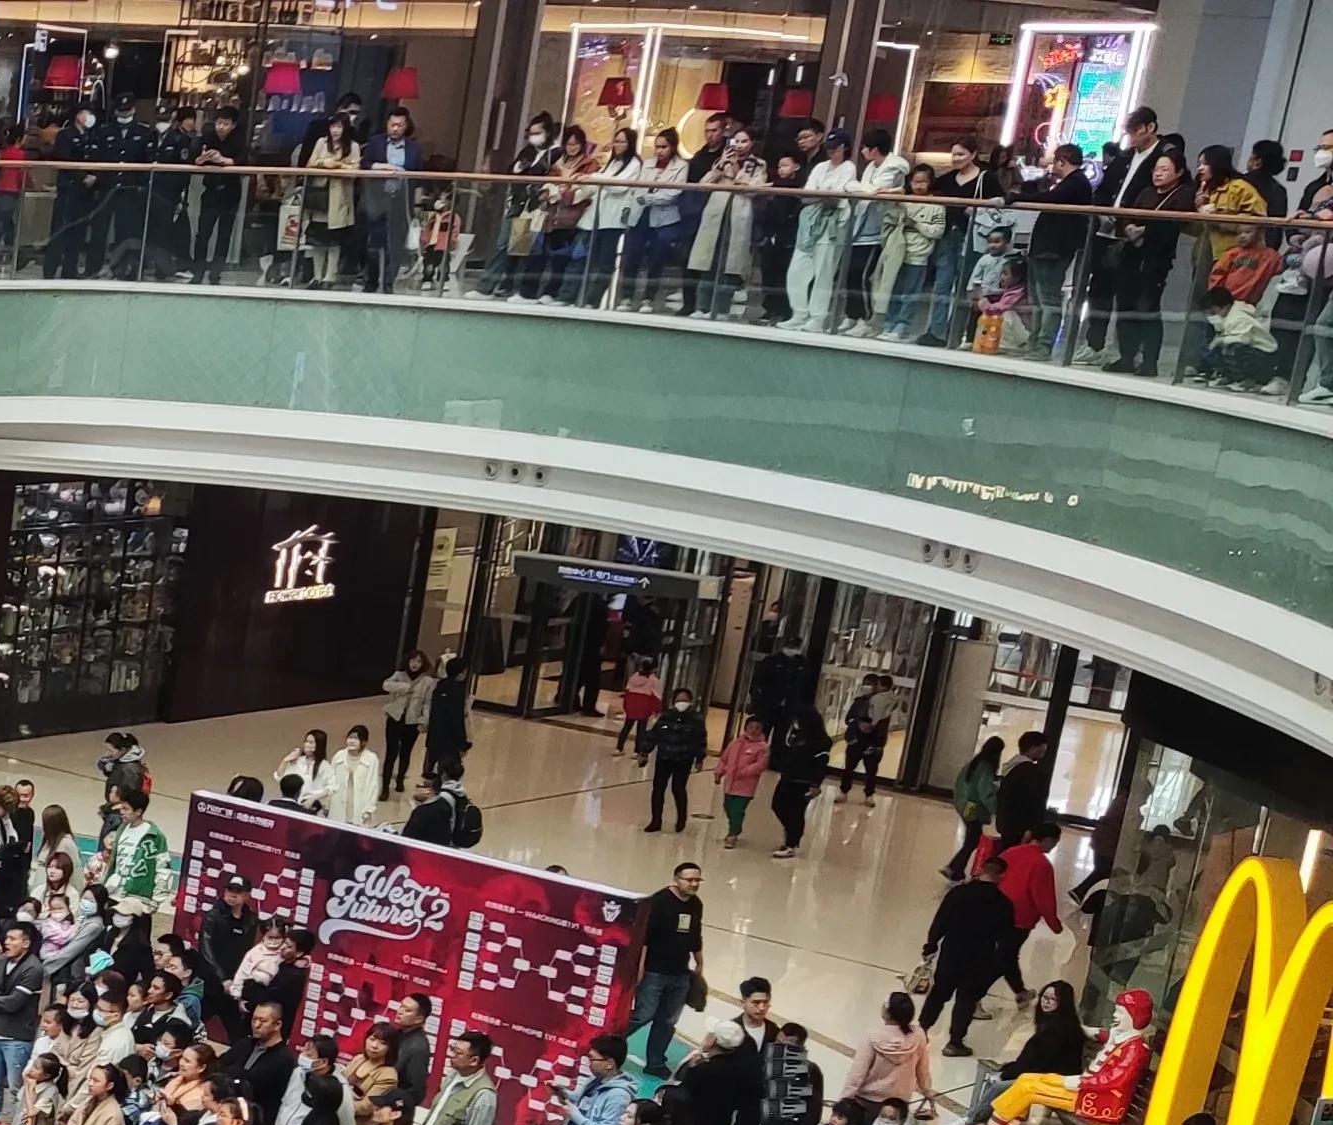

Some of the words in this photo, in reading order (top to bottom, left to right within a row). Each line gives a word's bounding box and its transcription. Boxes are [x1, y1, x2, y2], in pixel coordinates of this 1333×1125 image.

[325, 878, 421, 928] Future
[354, 864, 440, 918] West
[424, 898, 451, 932] 2
